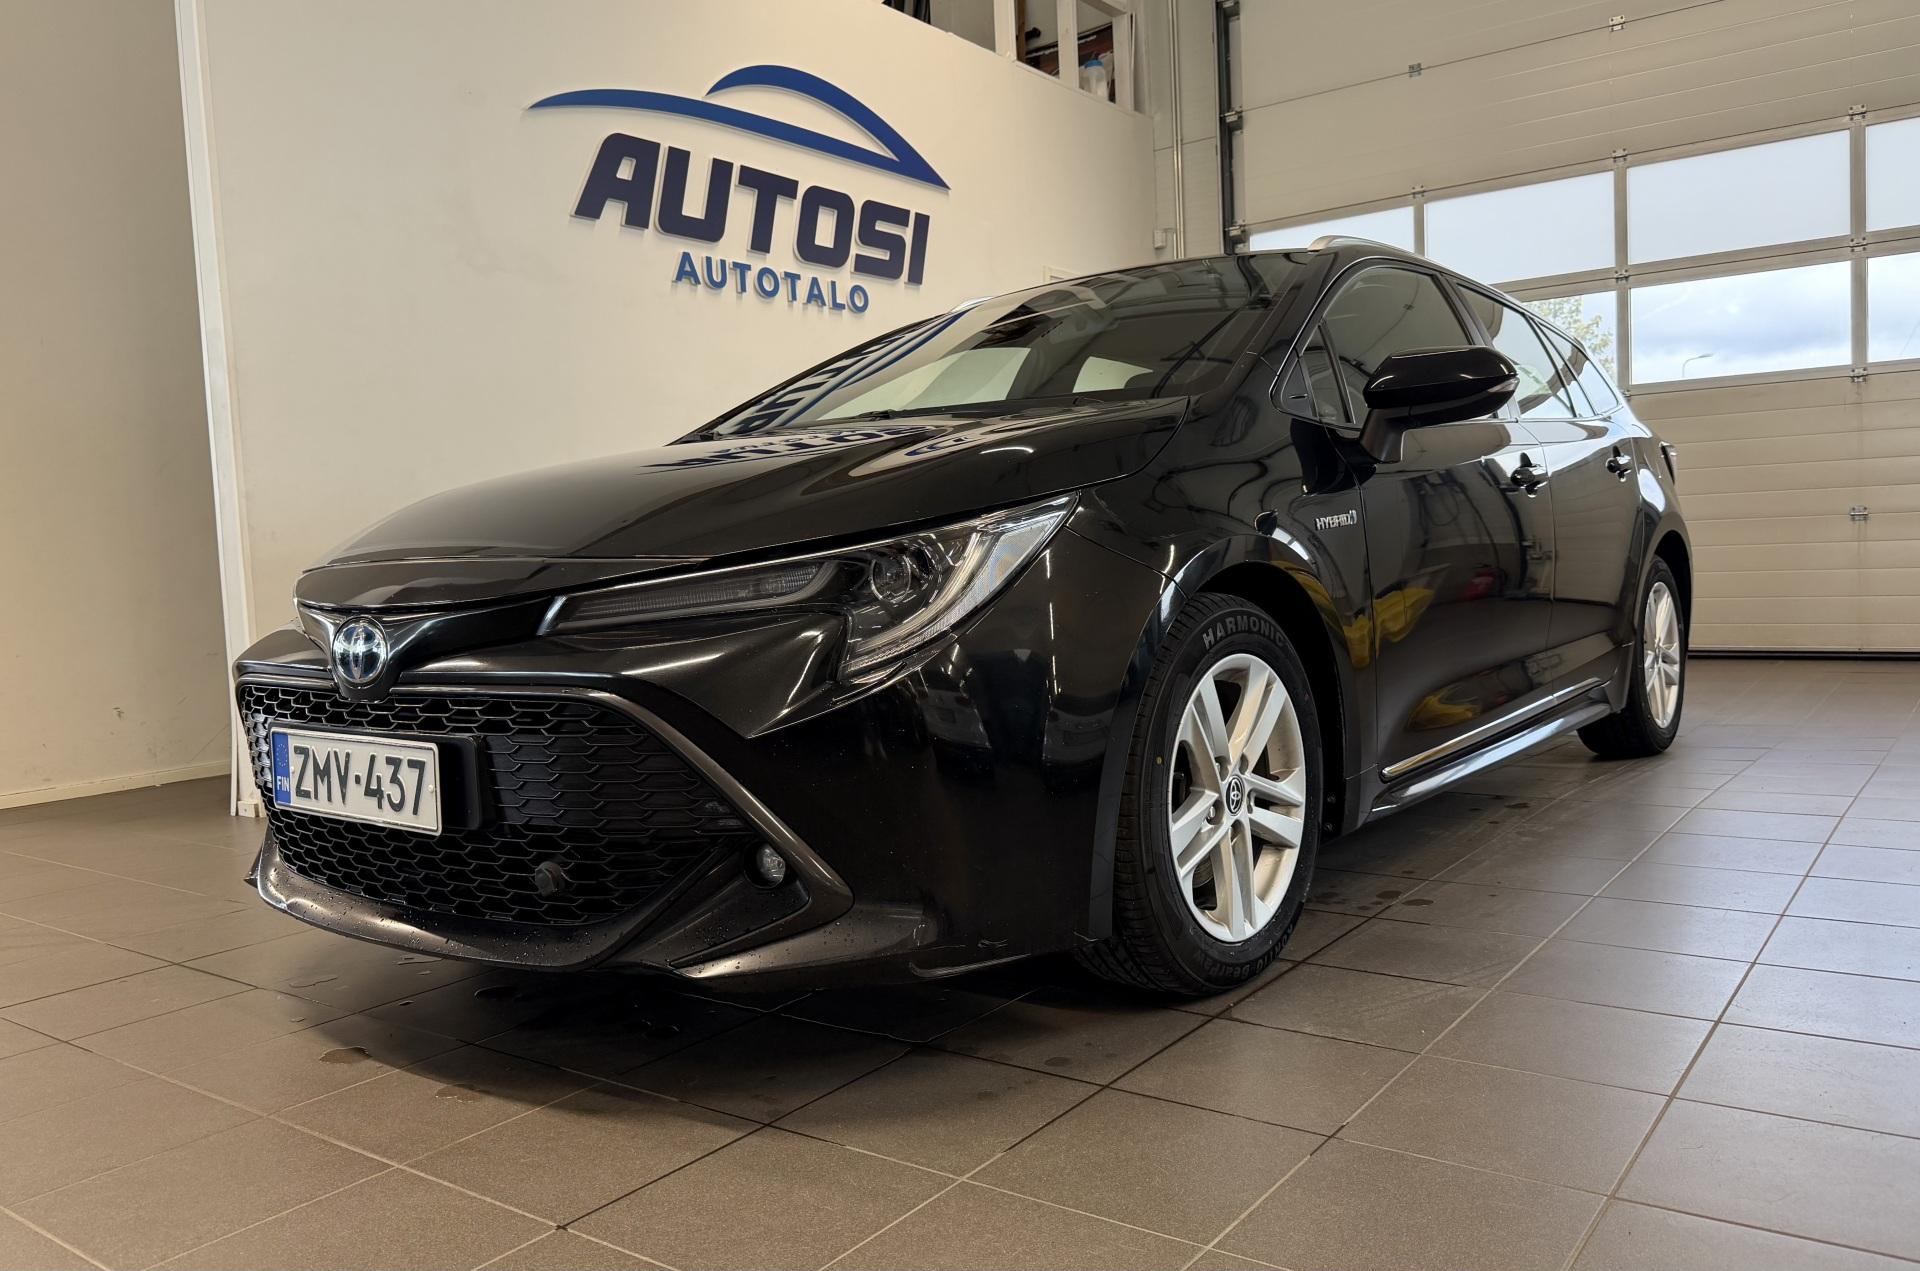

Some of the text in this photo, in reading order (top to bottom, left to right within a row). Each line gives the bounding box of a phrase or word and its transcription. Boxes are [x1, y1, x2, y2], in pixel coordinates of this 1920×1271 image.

[573, 132, 931, 286] AUTOSI
[674, 251, 869, 313] AUTOTALO
[1316, 513, 1351, 530] HYBRID
[1202, 615, 1285, 650] HARMONIC
[276, 775, 290, 792] FIN
